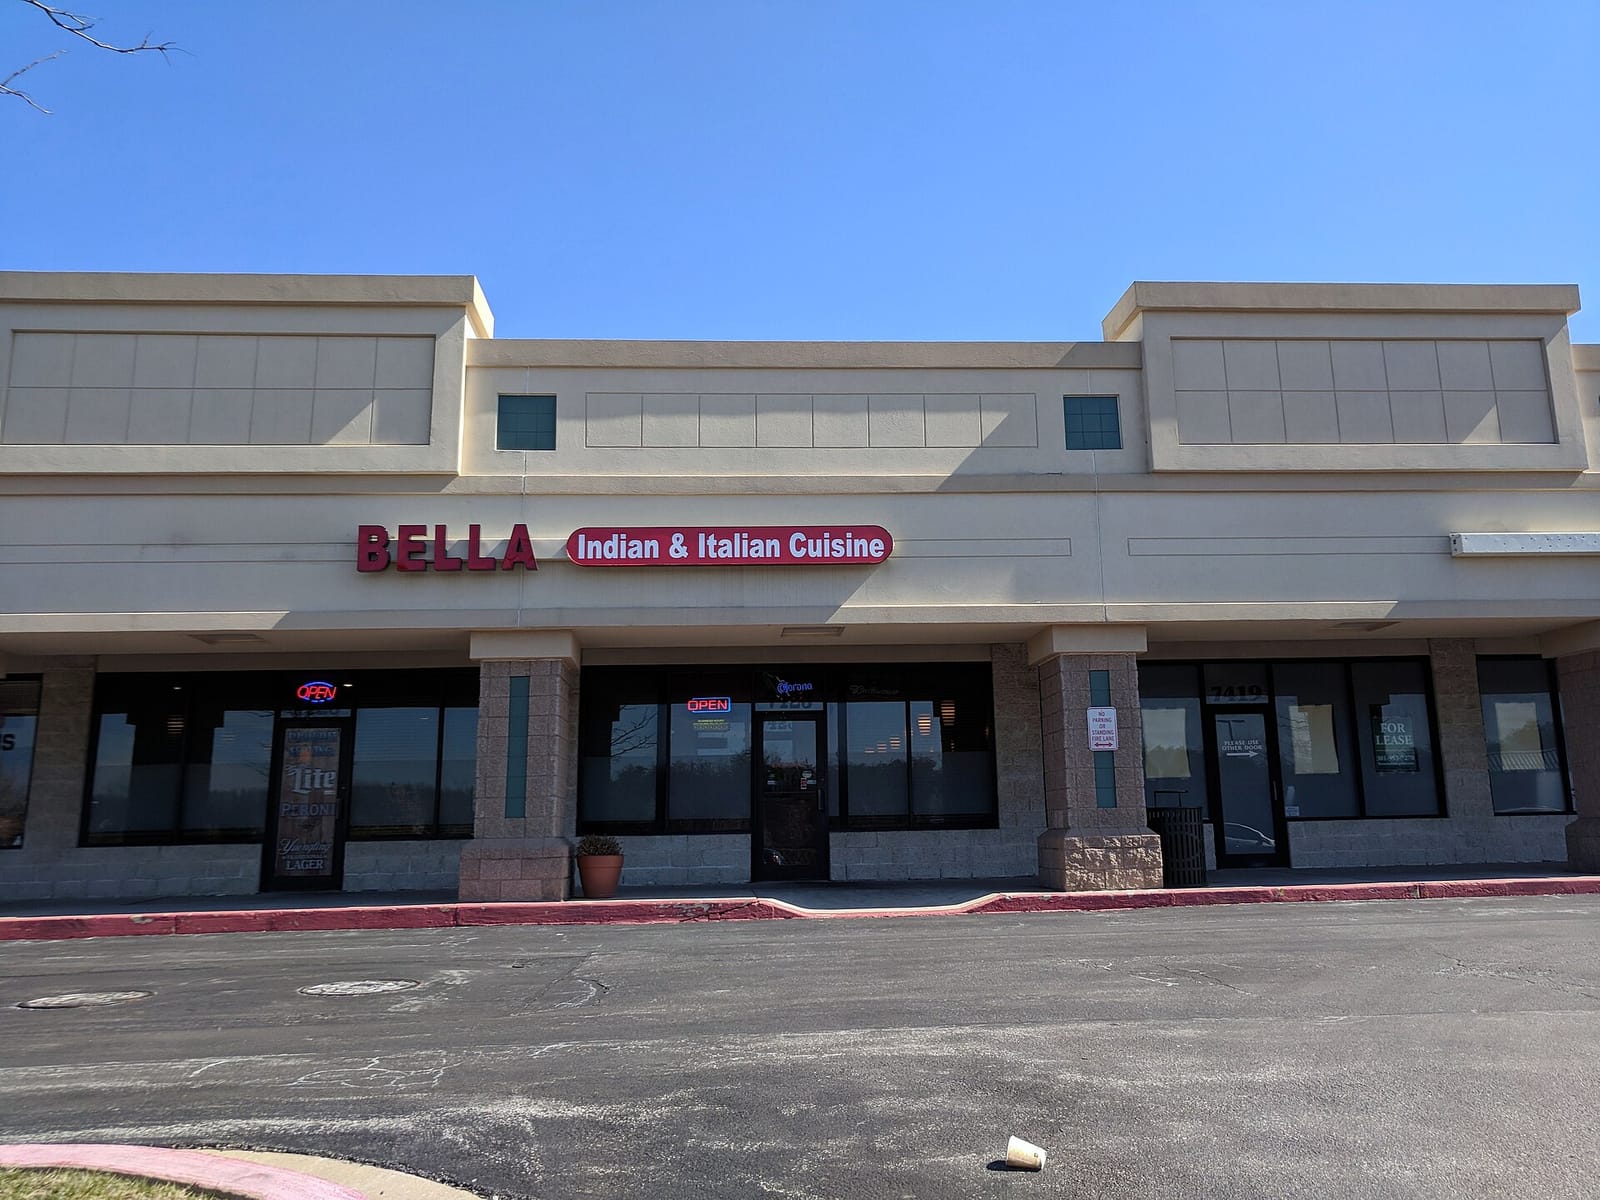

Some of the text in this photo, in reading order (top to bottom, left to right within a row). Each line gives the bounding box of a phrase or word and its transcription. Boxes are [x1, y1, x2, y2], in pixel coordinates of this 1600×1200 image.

[357, 524, 537, 572] BELLA
[577, 531, 885, 560] Indian & Italian Cuisine
[297, 685, 337, 699] OPEN
[777, 682, 813, 694] Corona
[687, 699, 728, 711] OPEN
[1380, 722, 1406, 733] FOR
[1376, 735, 1413, 745] LEASE
[287, 765, 337, 795] Lite
[281, 803, 336, 816] PERONI
[286, 860, 324, 870] LAGER
